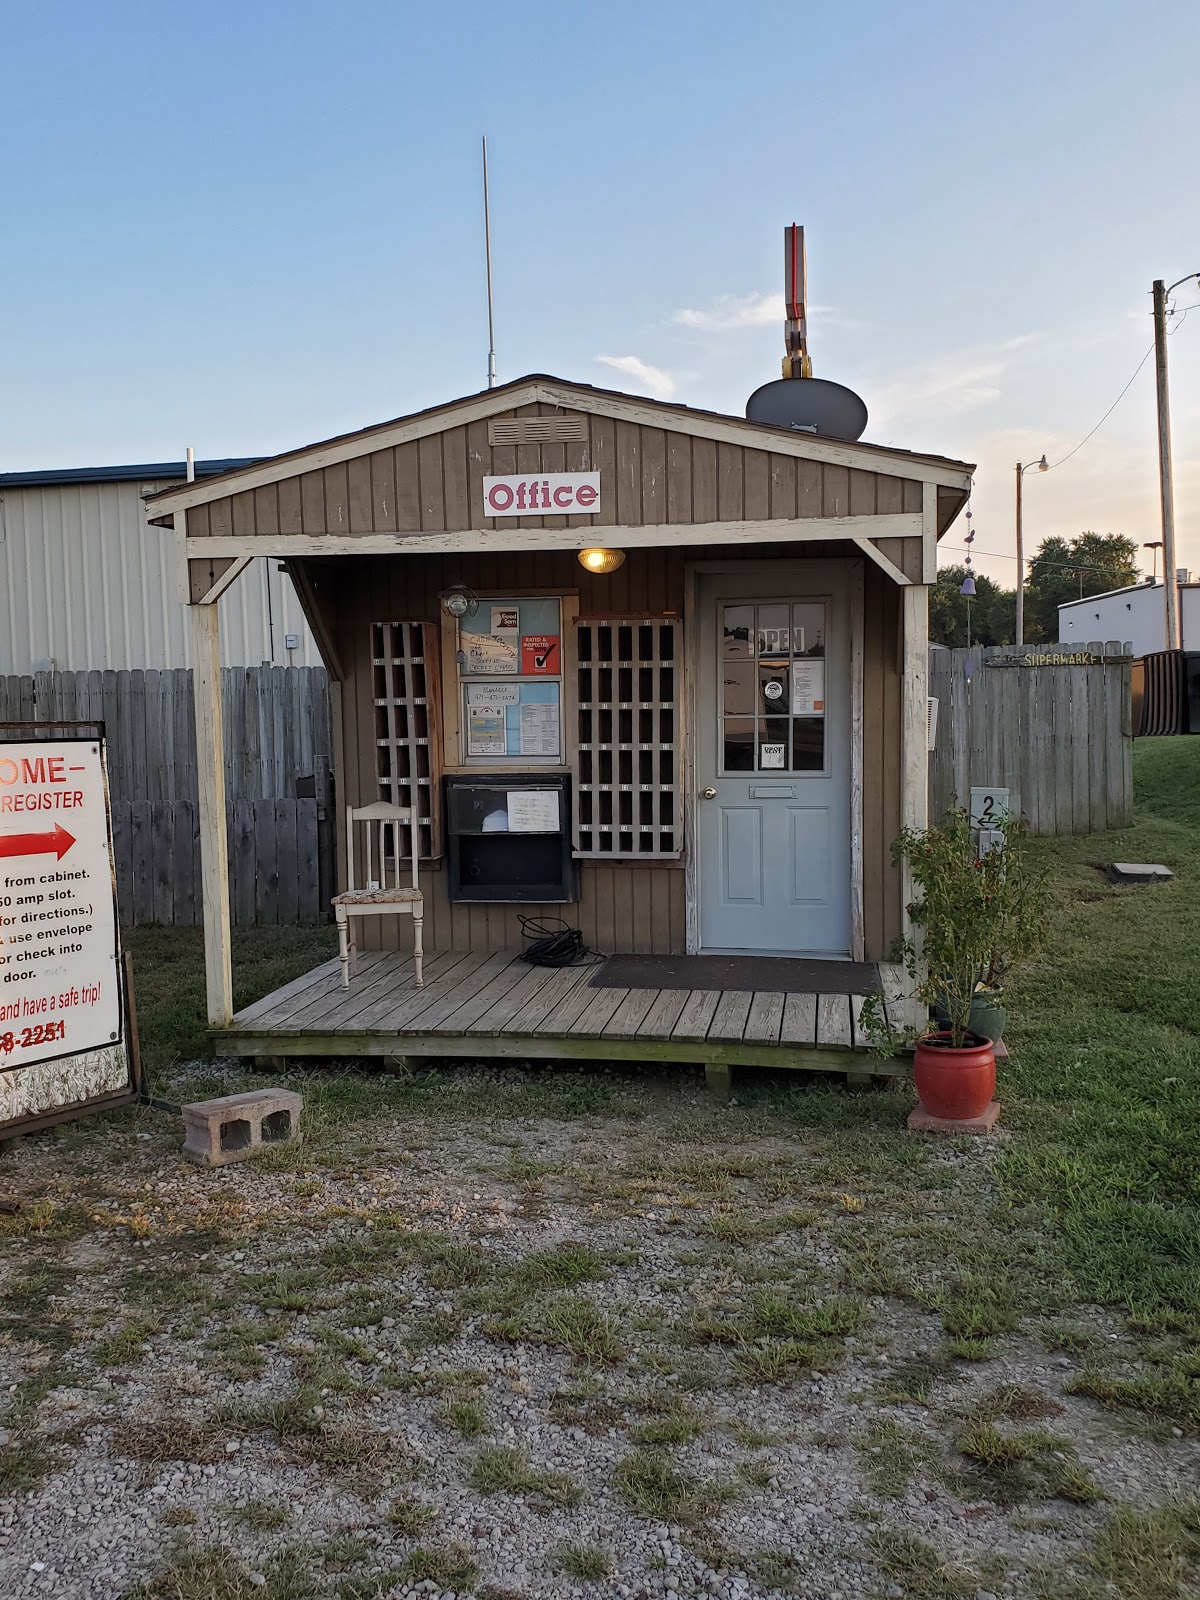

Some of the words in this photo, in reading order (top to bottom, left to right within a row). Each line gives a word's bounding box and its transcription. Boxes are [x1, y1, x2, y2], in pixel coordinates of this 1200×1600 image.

[489, 481, 597, 511] Office
[753, 629, 802, 653] OPEN
[1, 791, 83, 813] REGISTER
[983, 795, 995, 816] 2
[4, 877, 36, 888] from
[39, 869, 90, 884] cabinet.
[16, 894, 44, 905] amp
[48, 889, 76, 901] slot.
[21, 903, 93, 923] directions.)
[9, 933, 33, 944] use
[37, 924, 93, 940] envelope
[16, 946, 56, 962] check
[59, 943, 83, 955] into
[3, 970, 37, 983] door.
[0, 998, 21, 1021] and
[23, 996, 47, 1017] have
[49, 995, 56, 1011] a
[58, 986, 79, 1009] safe
[82, 981, 101, 1007] trip!
